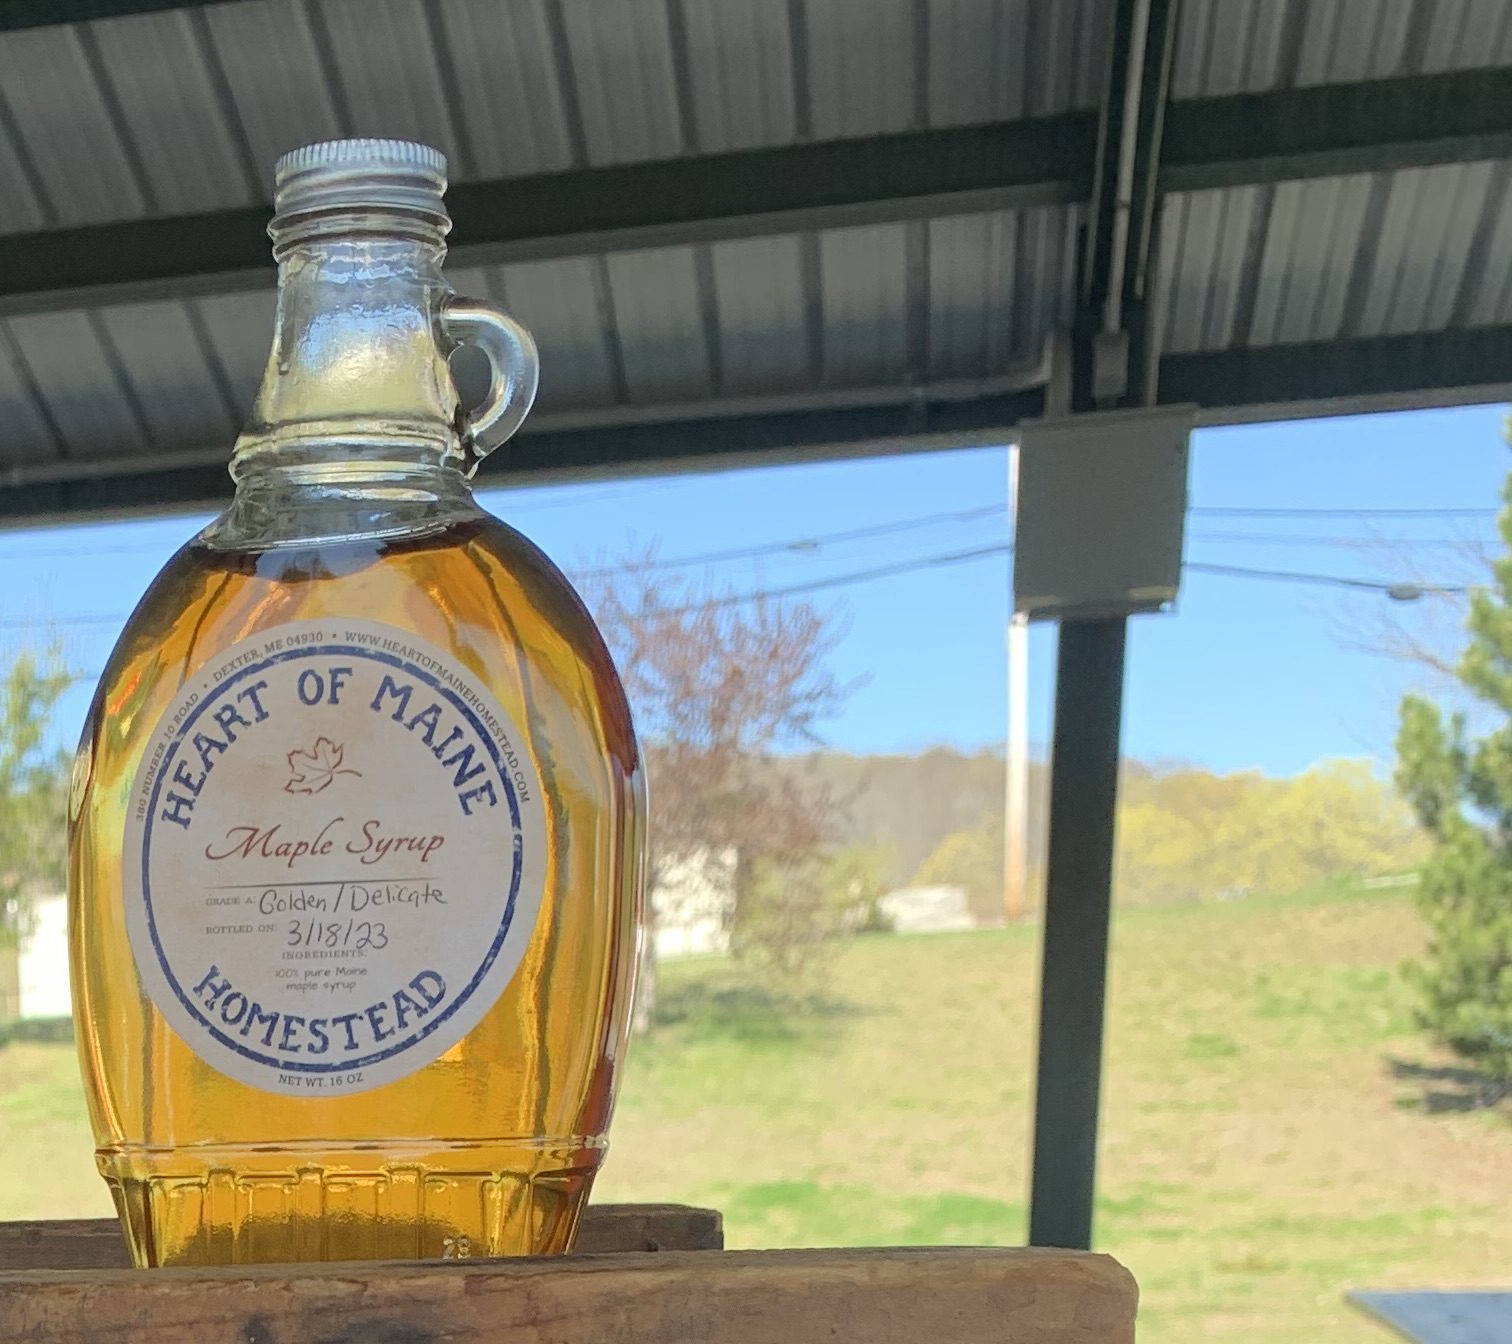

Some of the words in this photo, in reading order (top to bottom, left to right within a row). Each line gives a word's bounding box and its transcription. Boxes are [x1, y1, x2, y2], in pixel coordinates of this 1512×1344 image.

[161, 680, 269, 830] HEART
[297, 668, 353, 705] OF
[370, 675, 498, 815] MAINE
[264, 640, 283, 653] ME
[287, 633, 323, 646] 04930
[345, 632, 530, 803] WWW.HEARTOFMAINEHOMESTEAD.COM
[206, 817, 344, 868] Maple
[346, 820, 444, 865] Syrup
[192, 965, 446, 1054] HOMESTEAD
[279, 1074, 302, 1086] NET
[331, 1076, 342, 1086] 16
[347, 1073, 363, 1085] OZ
